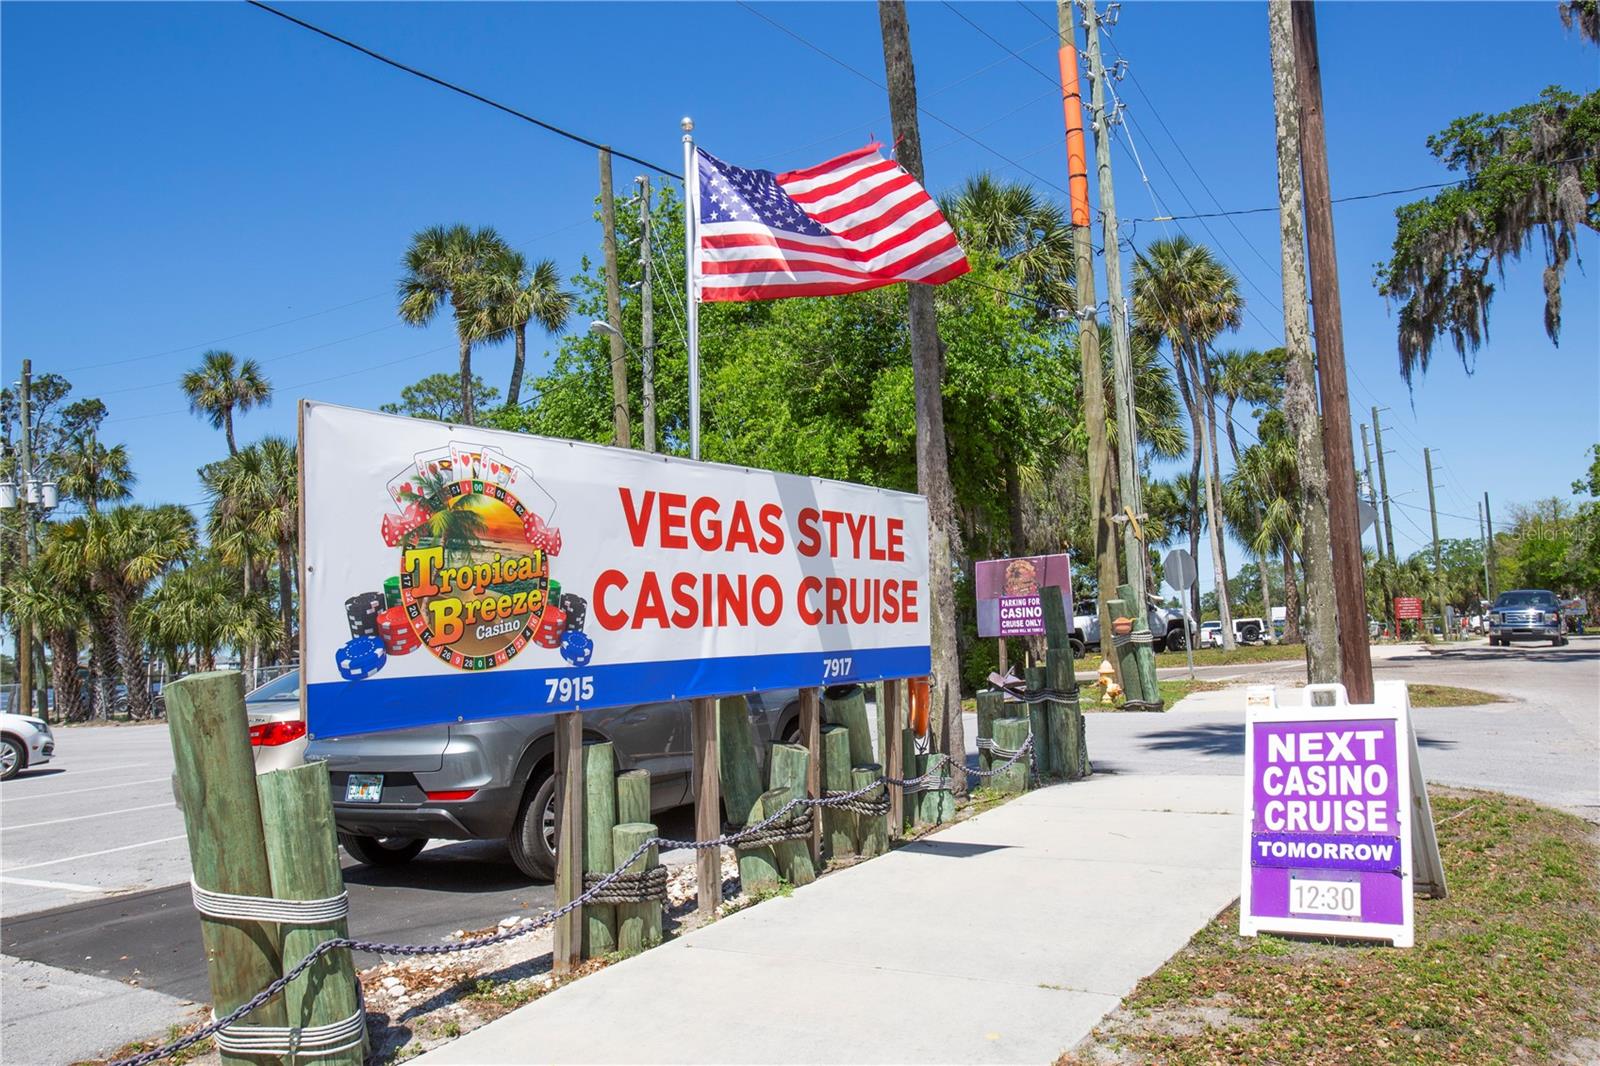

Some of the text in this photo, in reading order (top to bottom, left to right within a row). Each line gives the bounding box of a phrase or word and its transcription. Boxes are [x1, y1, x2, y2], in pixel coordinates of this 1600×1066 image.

[618, 487, 904, 562] VEGAS STYLE
[405, 546, 543, 598] Tropical
[592, 569, 918, 631] CASINO CRUISE
[1001, 597, 1040, 607] PARKING FOR
[1001, 606, 1042, 619] CASINO
[428, 589, 543, 647] Breeze
[476, 619, 521, 640] Casino
[1001, 619, 1041, 628] CRUISE ONLY
[823, 658, 852, 678] 7917
[545, 676, 594, 703] 7915
[1267, 730, 1384, 762] NEXT
[1262, 764, 1388, 796] CASINO
[1264, 800, 1388, 832] CRUISE
[1258, 841, 1393, 861] TOMORROW
[1295, 885, 1354, 911] 12:30
